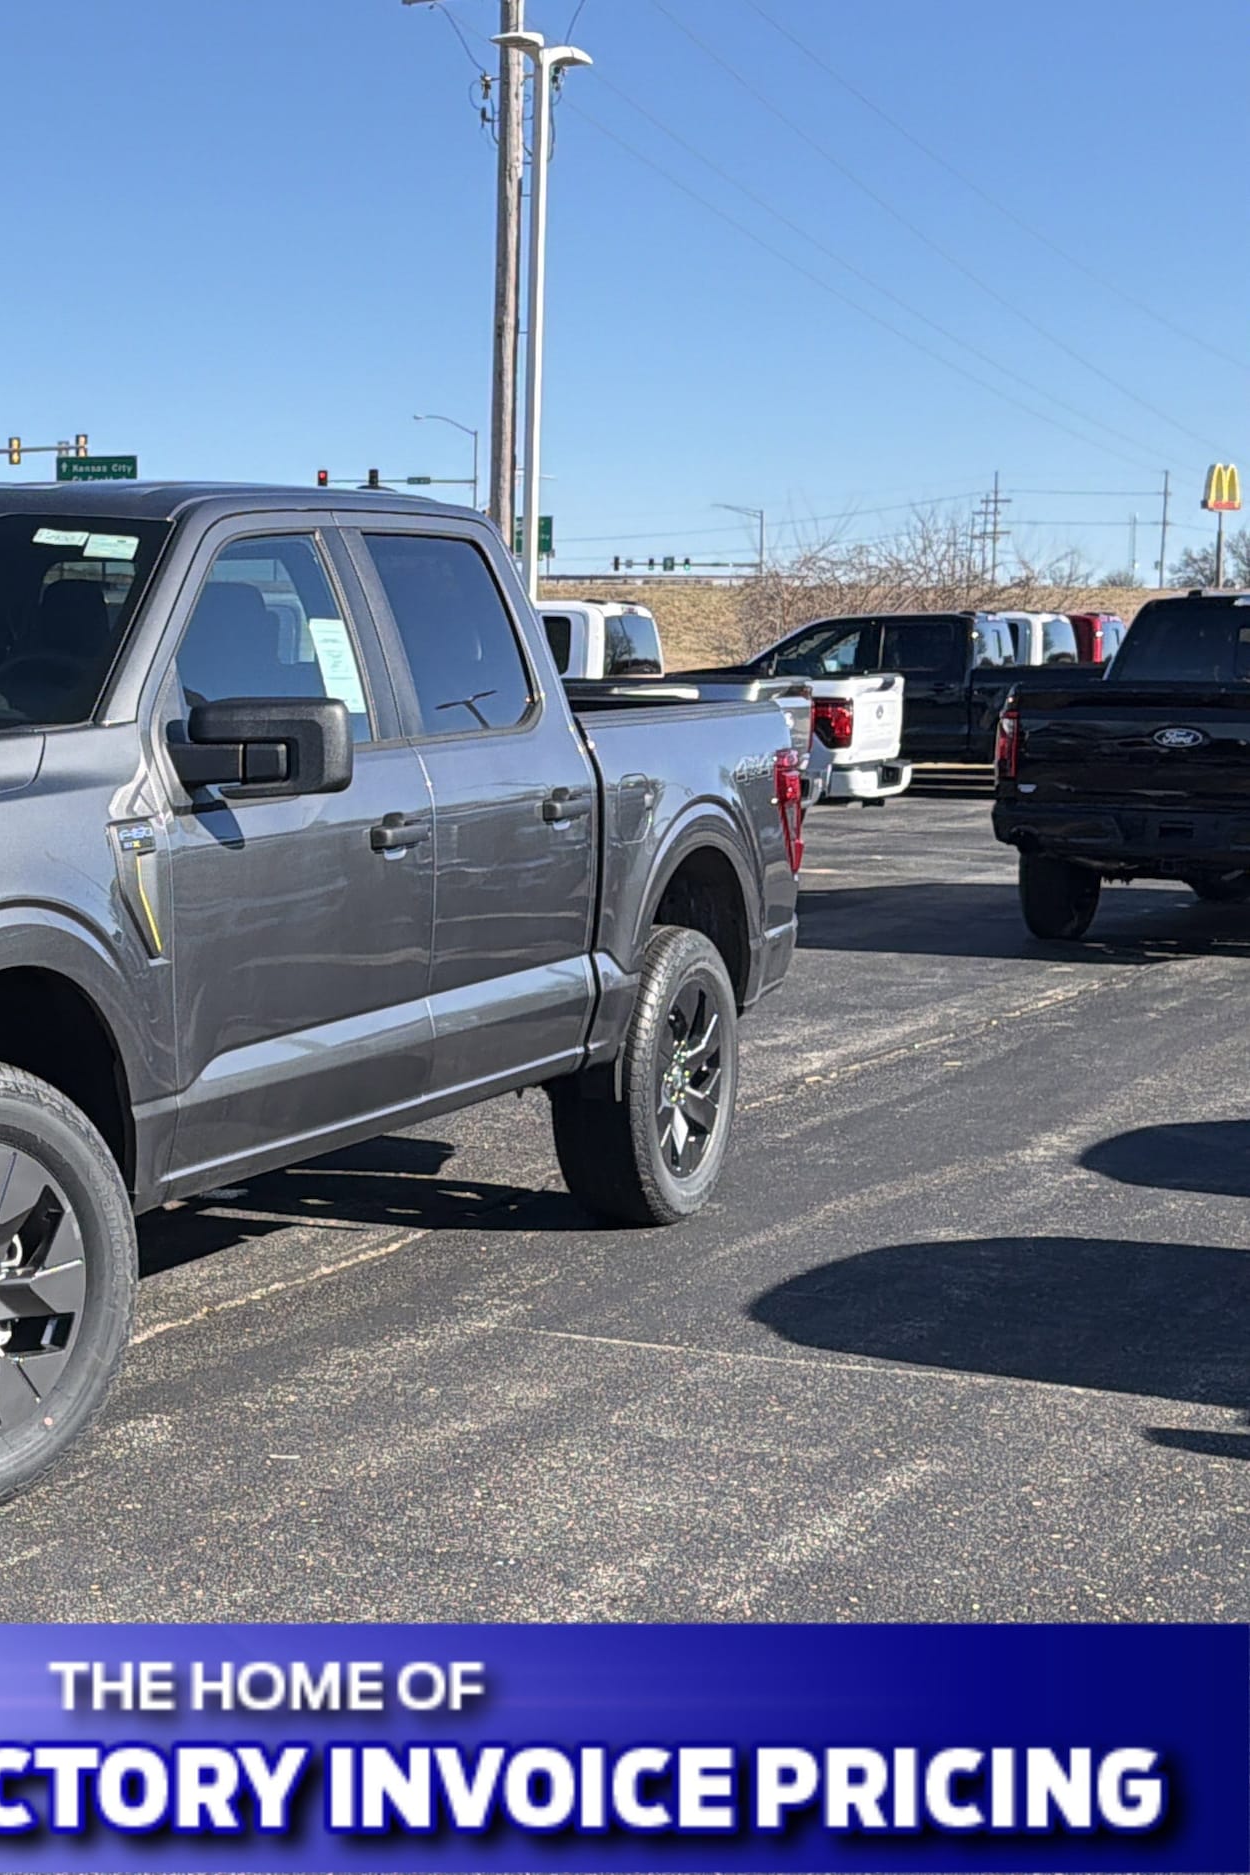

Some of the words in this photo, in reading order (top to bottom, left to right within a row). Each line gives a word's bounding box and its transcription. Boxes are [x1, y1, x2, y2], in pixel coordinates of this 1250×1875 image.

[71, 463, 107, 473] Kansas
[111, 463, 133, 474] City
[1161, 729, 1195, 744] Ford
